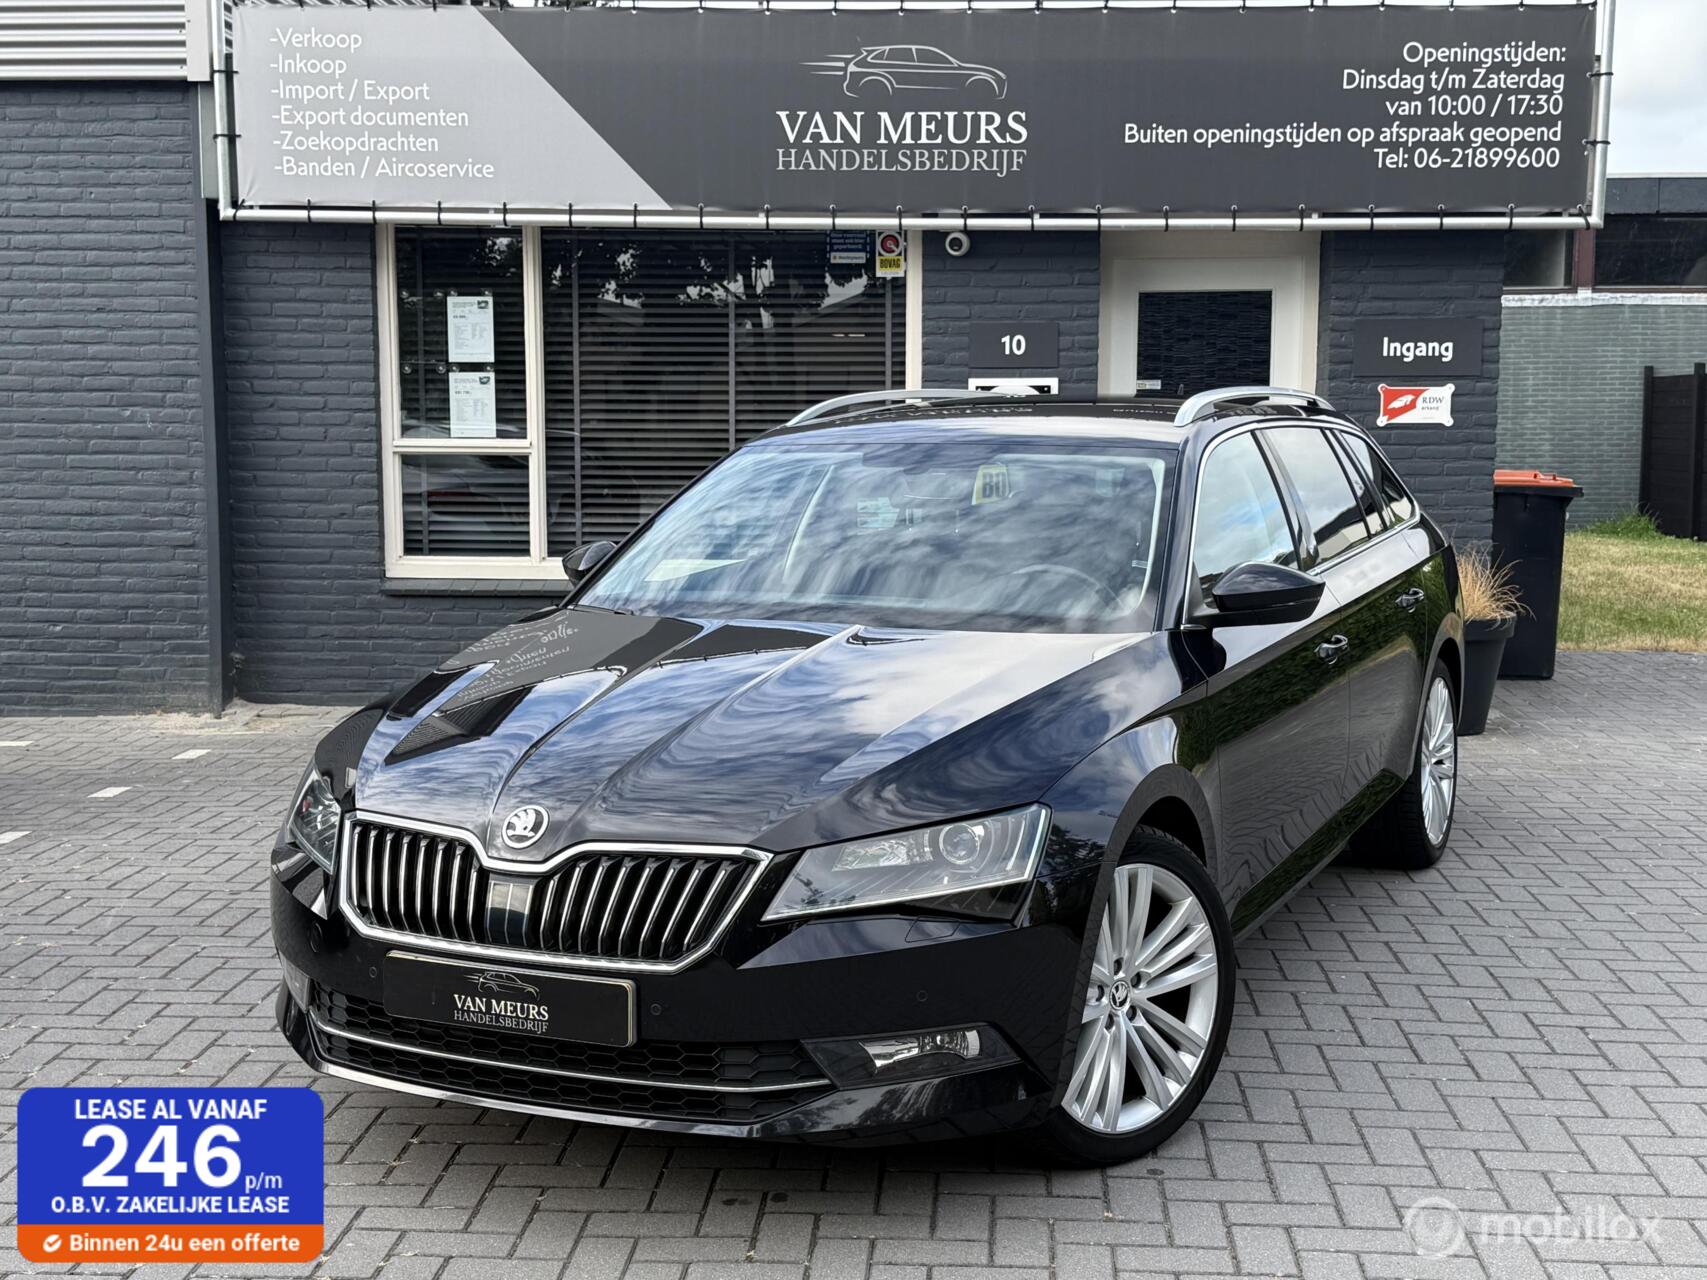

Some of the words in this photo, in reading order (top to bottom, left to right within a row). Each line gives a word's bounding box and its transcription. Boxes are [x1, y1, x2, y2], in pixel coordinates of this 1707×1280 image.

[269, 28, 363, 53] -Verkoop
[270, 53, 348, 78] -Inkoop
[1402, 41, 1567, 67] Openingstijden:
[271, 79, 344, 103] -Import
[347, 79, 358, 102] /
[363, 81, 431, 104] Export
[1342, 69, 1425, 94] Dinsdag
[1429, 69, 1467, 92] t/m
[1471, 69, 1566, 94] Zaterdag
[272, 105, 347, 129] -Export
[350, 106, 469, 127] documenten
[1385, 100, 1422, 116] van
[1427, 96, 1486, 116] 10:00
[1490, 95, 1502, 119] /
[1507, 96, 1564, 116] 17:30
[776, 110, 865, 144] VAN
[876, 110, 1029, 145] MEURS
[1124, 123, 1188, 144] Buiten
[1193, 122, 1342, 148] openingstijden
[1346, 127, 1375, 147] op
[1379, 122, 1465, 147] afspraak
[1469, 121, 1562, 147] geopend
[273, 131, 439, 155] -Zoekopdrachten
[274, 157, 356, 178] -Banden
[360, 156, 371, 180] /
[375, 157, 495, 179] Aircoservice
[776, 148, 1028, 178] HANDELSBEDRIJF
[1374, 148, 1409, 168] Tel:
[1413, 148, 1560, 169] 06-21899600
[880, 258, 901, 269] BOVAG
[1001, 335, 1026, 355] 10
[1382, 337, 1454, 362] Ingang
[1422, 396, 1445, 404] RDW
[453, 994, 487, 1013] VAN
[491, 1000, 549, 1021] MEURS
[453, 1010, 549, 1034] HANDELSBEDRIJF
